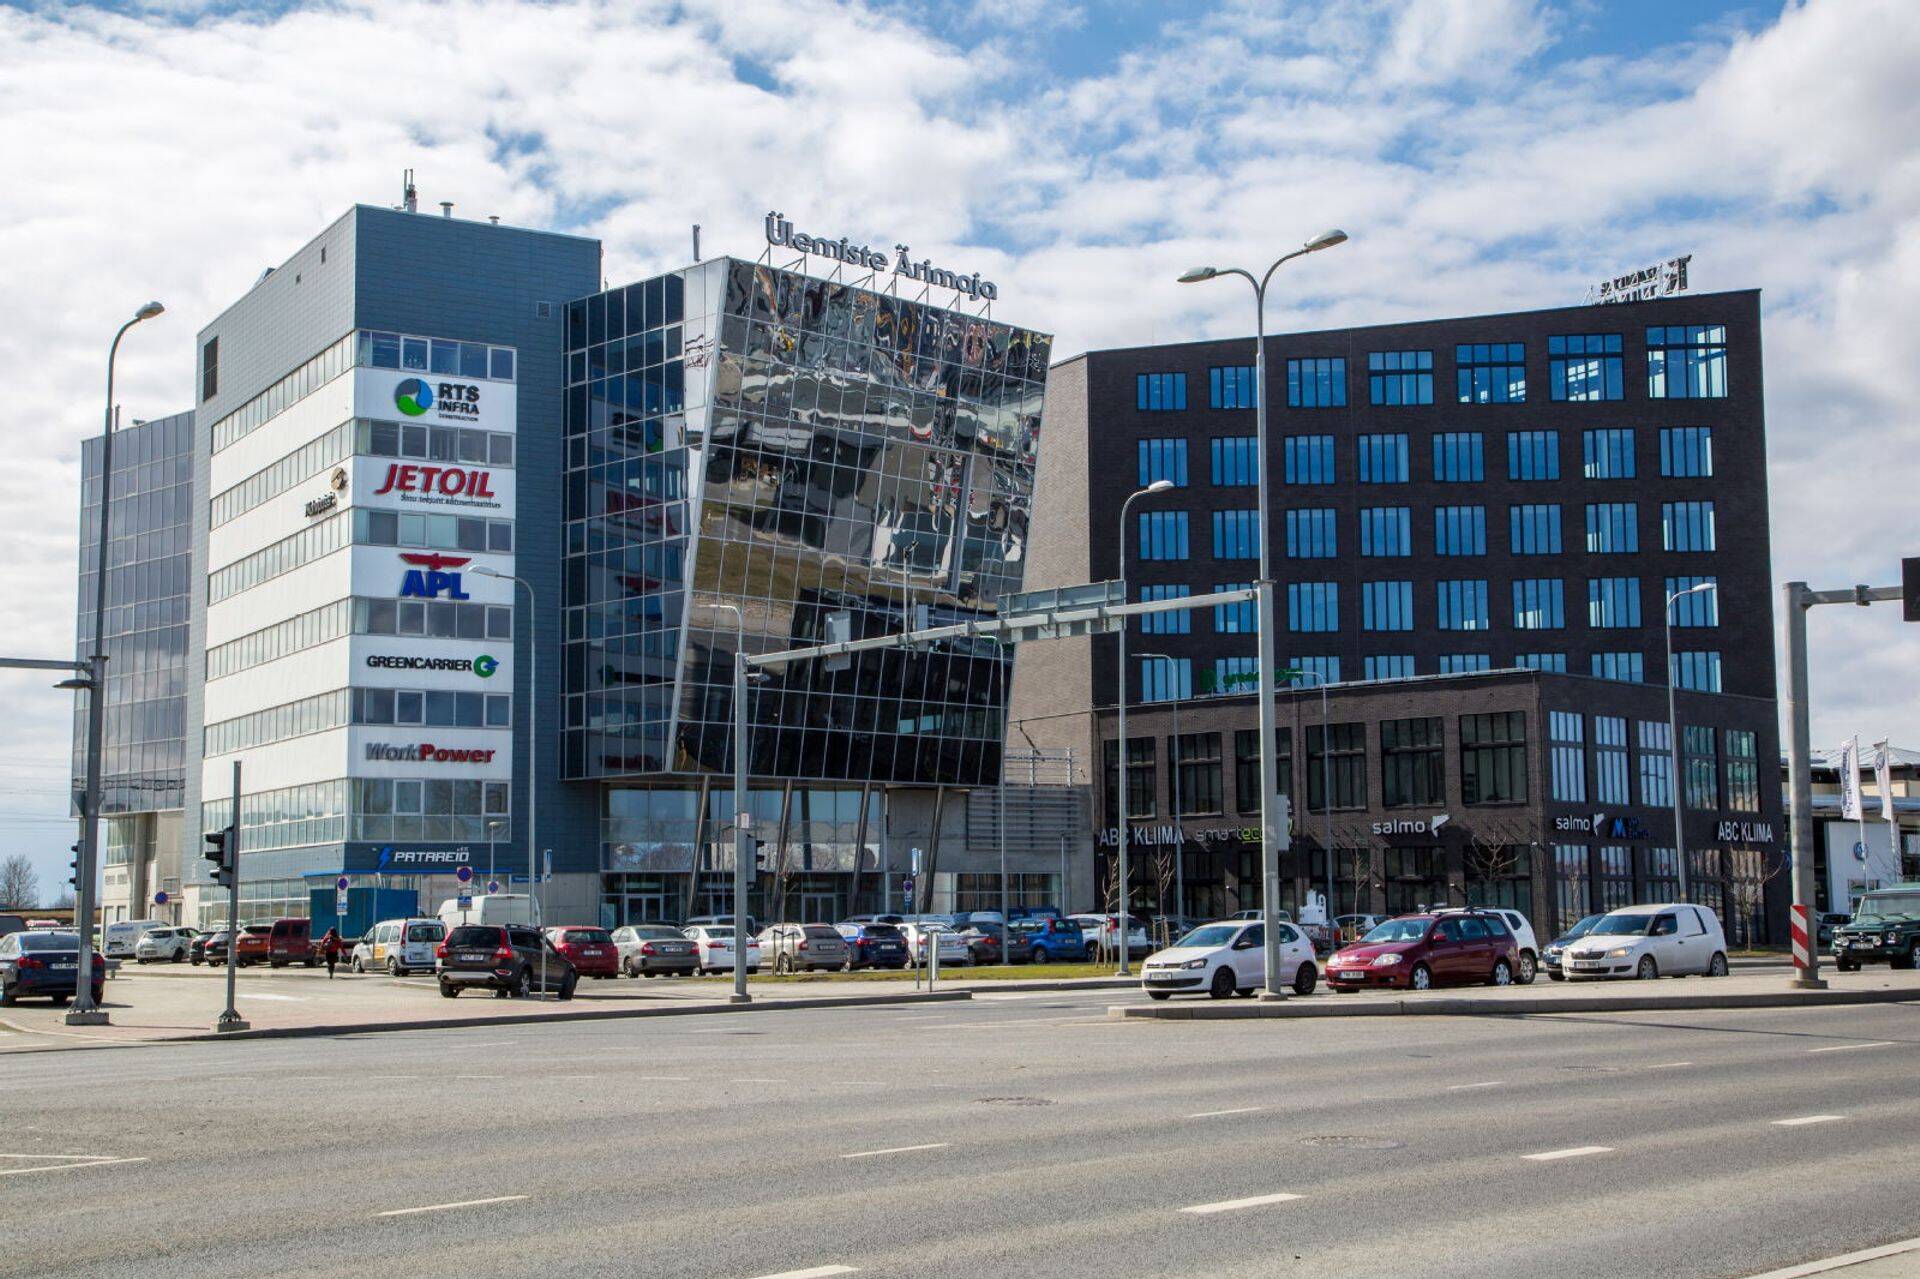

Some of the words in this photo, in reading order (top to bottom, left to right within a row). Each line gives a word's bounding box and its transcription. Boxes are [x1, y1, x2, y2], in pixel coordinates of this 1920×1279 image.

[765, 210, 889, 272] Ülemiste
[894, 243, 998, 301] Ärimaja
[438, 382, 480, 403] RTS
[438, 400, 480, 415] INFRA
[373, 463, 495, 499] JETOIL
[400, 569, 470, 600] APL
[366, 655, 473, 672] GREENCARRIER
[365, 742, 496, 764] WorkPower
[1372, 819, 1425, 835] salmo
[1555, 815, 1591, 831] salmo
[1717, 821, 1740, 842] ABC
[1741, 823, 1774, 843] KLIIMA
[1099, 827, 1129, 846] AB
[1134, 826, 1185, 845] KLIIMA
[394, 851, 470, 863] PATAREID
